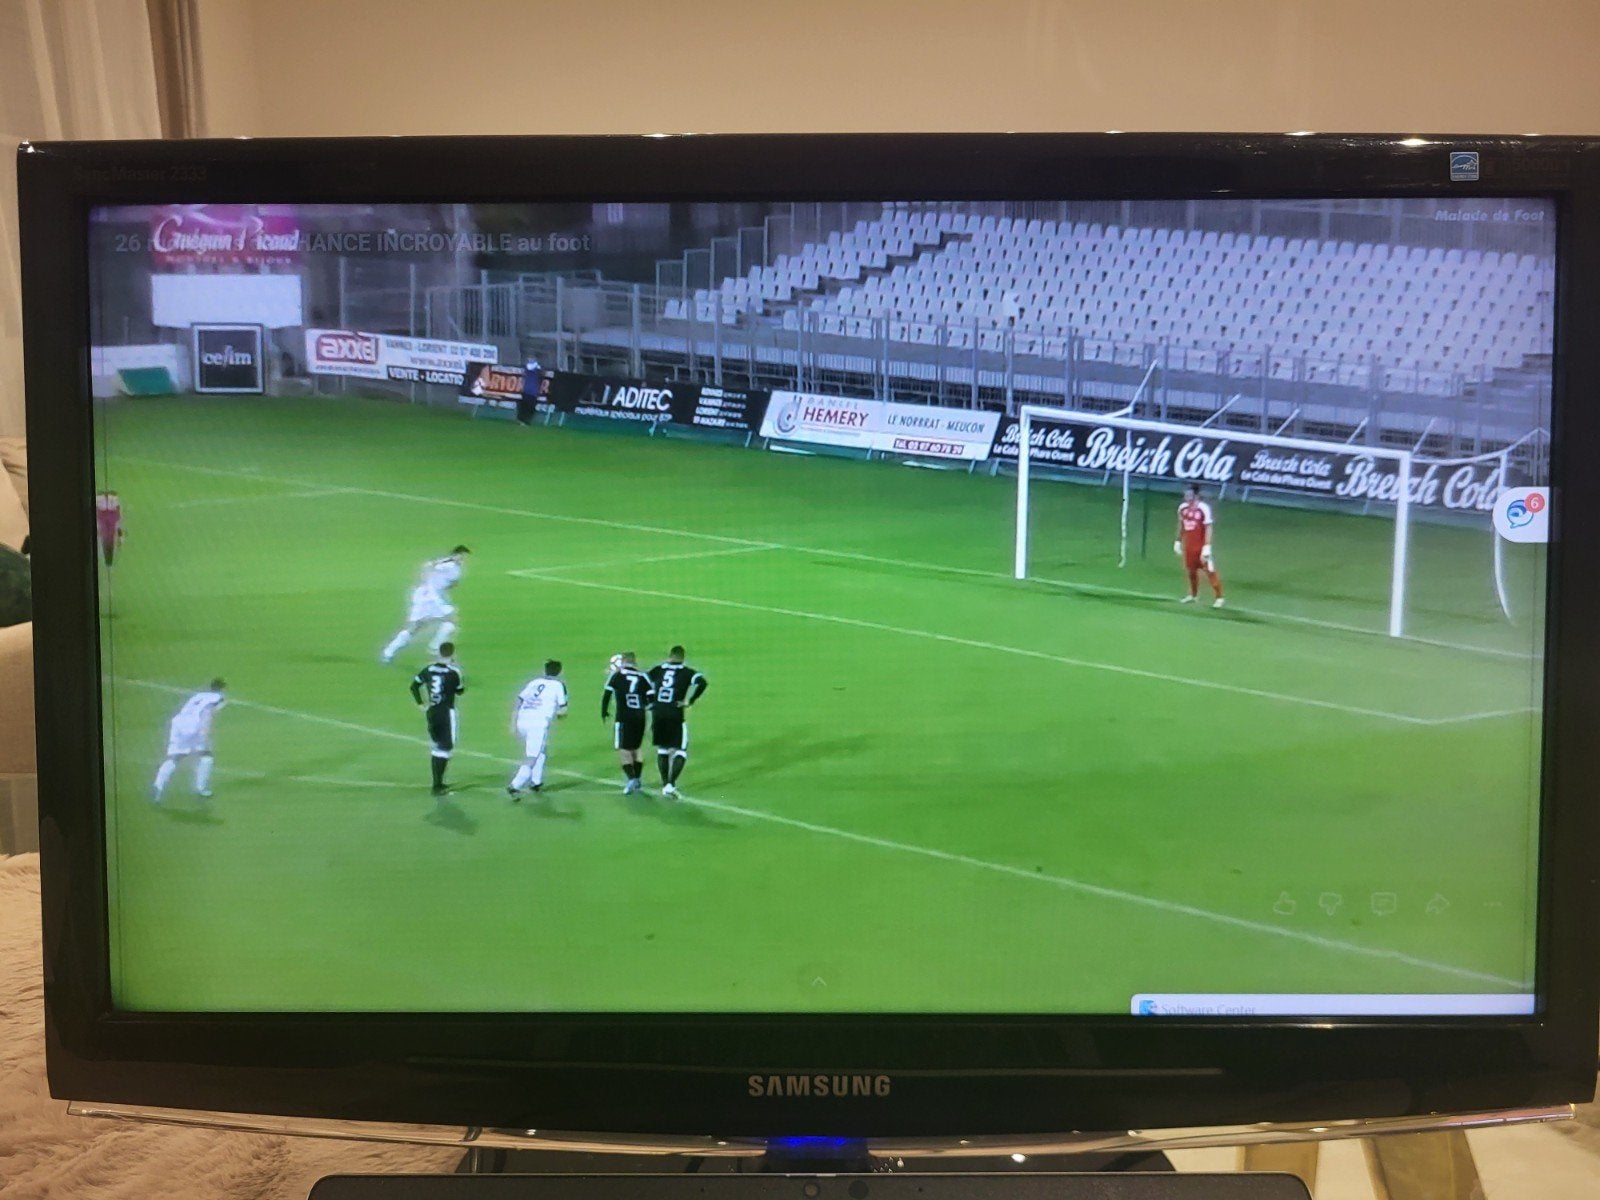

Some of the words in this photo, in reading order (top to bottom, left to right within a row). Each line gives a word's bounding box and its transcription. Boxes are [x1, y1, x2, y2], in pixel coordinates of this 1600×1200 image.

[1434, 209, 1489, 222] Malade
[1493, 209, 1510, 222] de
[1514, 209, 1545, 222] Foot
[114, 233, 142, 252] 26
[298, 232, 370, 252] HANCE
[377, 232, 511, 252] INCROYABLE
[516, 236, 542, 252] au
[547, 231, 591, 252] foot
[612, 386, 673, 411] ADITEC
[803, 406, 870, 428] HEMERY
[1045, 428, 1075, 450] Cola
[1076, 426, 1171, 476] Breizh
[1172, 438, 1237, 482] Cola
[1299, 456, 1333, 477] Cola
[1531, 497, 1539, 508] 6
[430, 675, 442, 693] 3
[626, 675, 639, 693] 7
[662, 670, 675, 688] 5
[533, 683, 546, 698] 9
[1160, 1003, 1214, 1016] Software
[1216, 1003, 1257, 1016] Center
[747, 1075, 892, 1097] SAMSUNG
